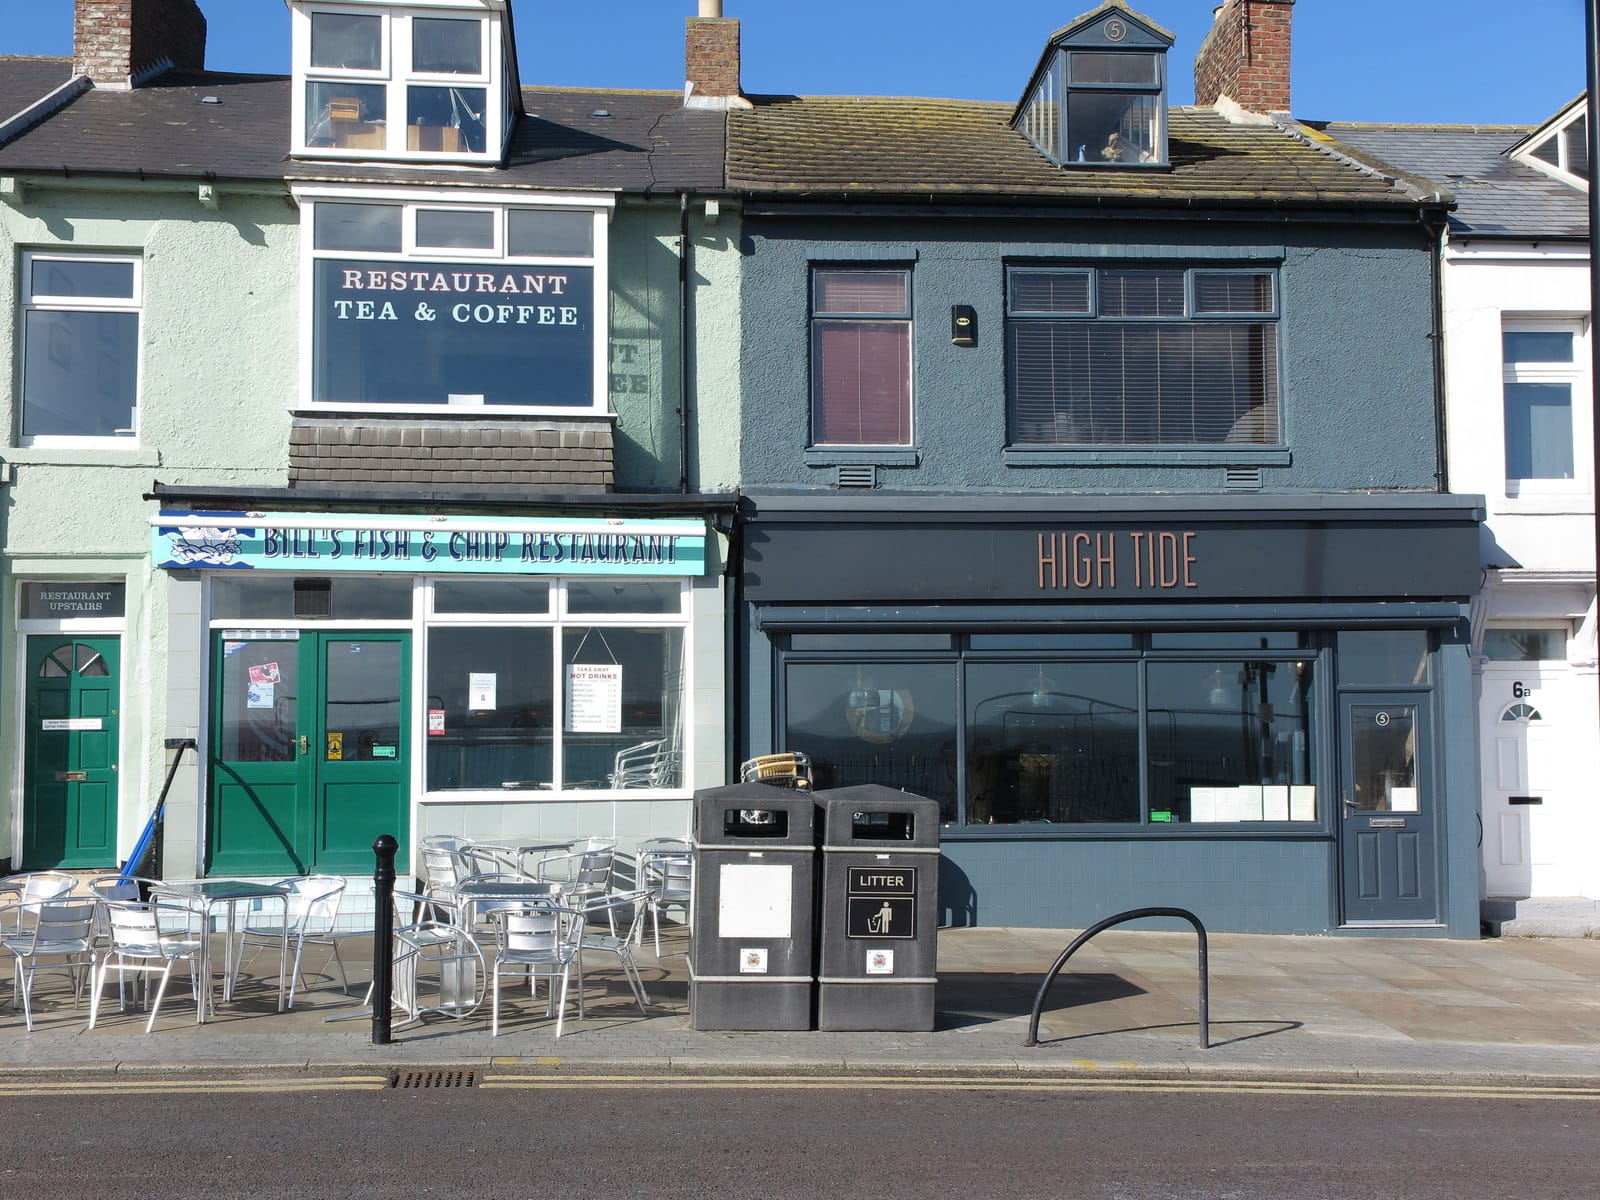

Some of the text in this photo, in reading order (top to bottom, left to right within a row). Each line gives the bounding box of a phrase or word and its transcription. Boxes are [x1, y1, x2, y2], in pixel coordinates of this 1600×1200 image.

[343, 270, 568, 295] RESTAURANT
[334, 300, 577, 326] TEA & COFFEE
[263, 527, 681, 564] BILL'S FISH & CHIP RESTAURANT
[1038, 531, 1198, 589] HIGH TIDE
[40, 591, 112, 600] RESTAURANT
[49, 602, 103, 611] UPSTAIRS
[1512, 681, 1531, 699] 6a
[860, 875, 904, 886] LITTER
